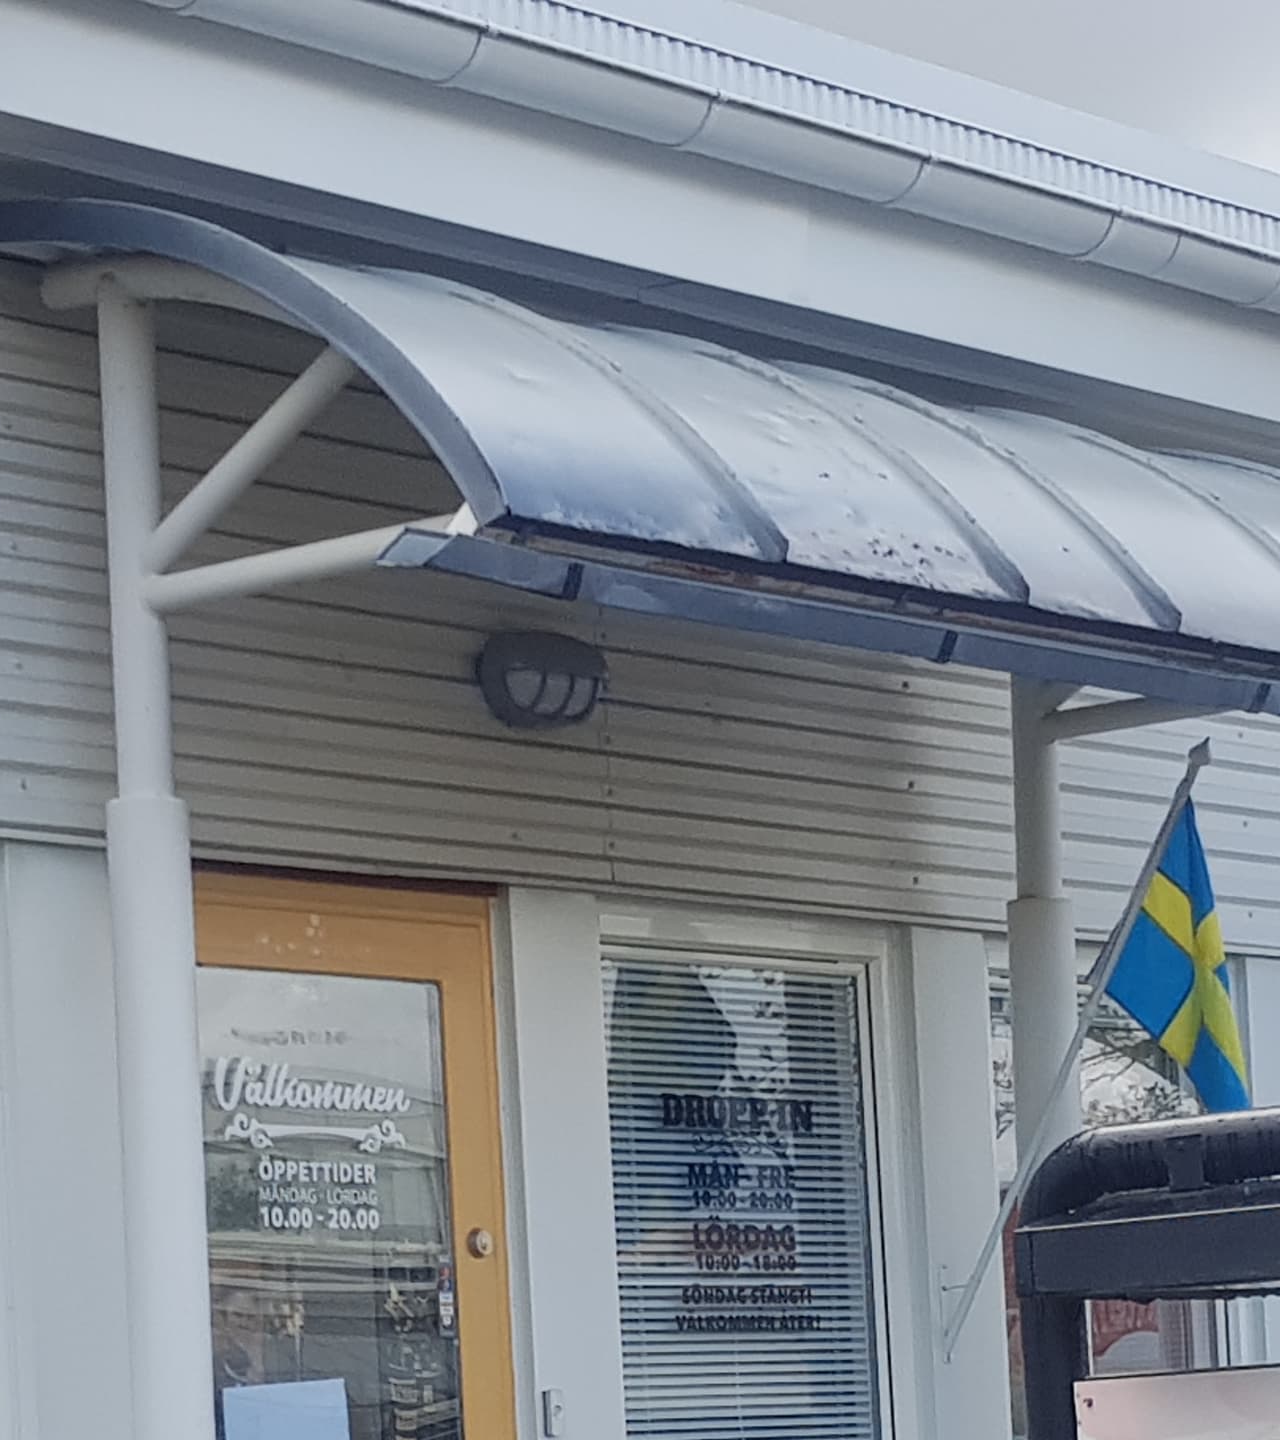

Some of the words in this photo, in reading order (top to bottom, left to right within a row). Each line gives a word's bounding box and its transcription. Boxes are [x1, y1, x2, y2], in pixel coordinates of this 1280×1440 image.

[214, 1055, 411, 1113] Välkommen
[259, 1154, 376, 1185] ÖPPETTIDER
[260, 1206, 313, 1229] 10.00
[327, 1207, 380, 1231] 20.00
[693, 1214, 797, 1252] LÖRDAG
